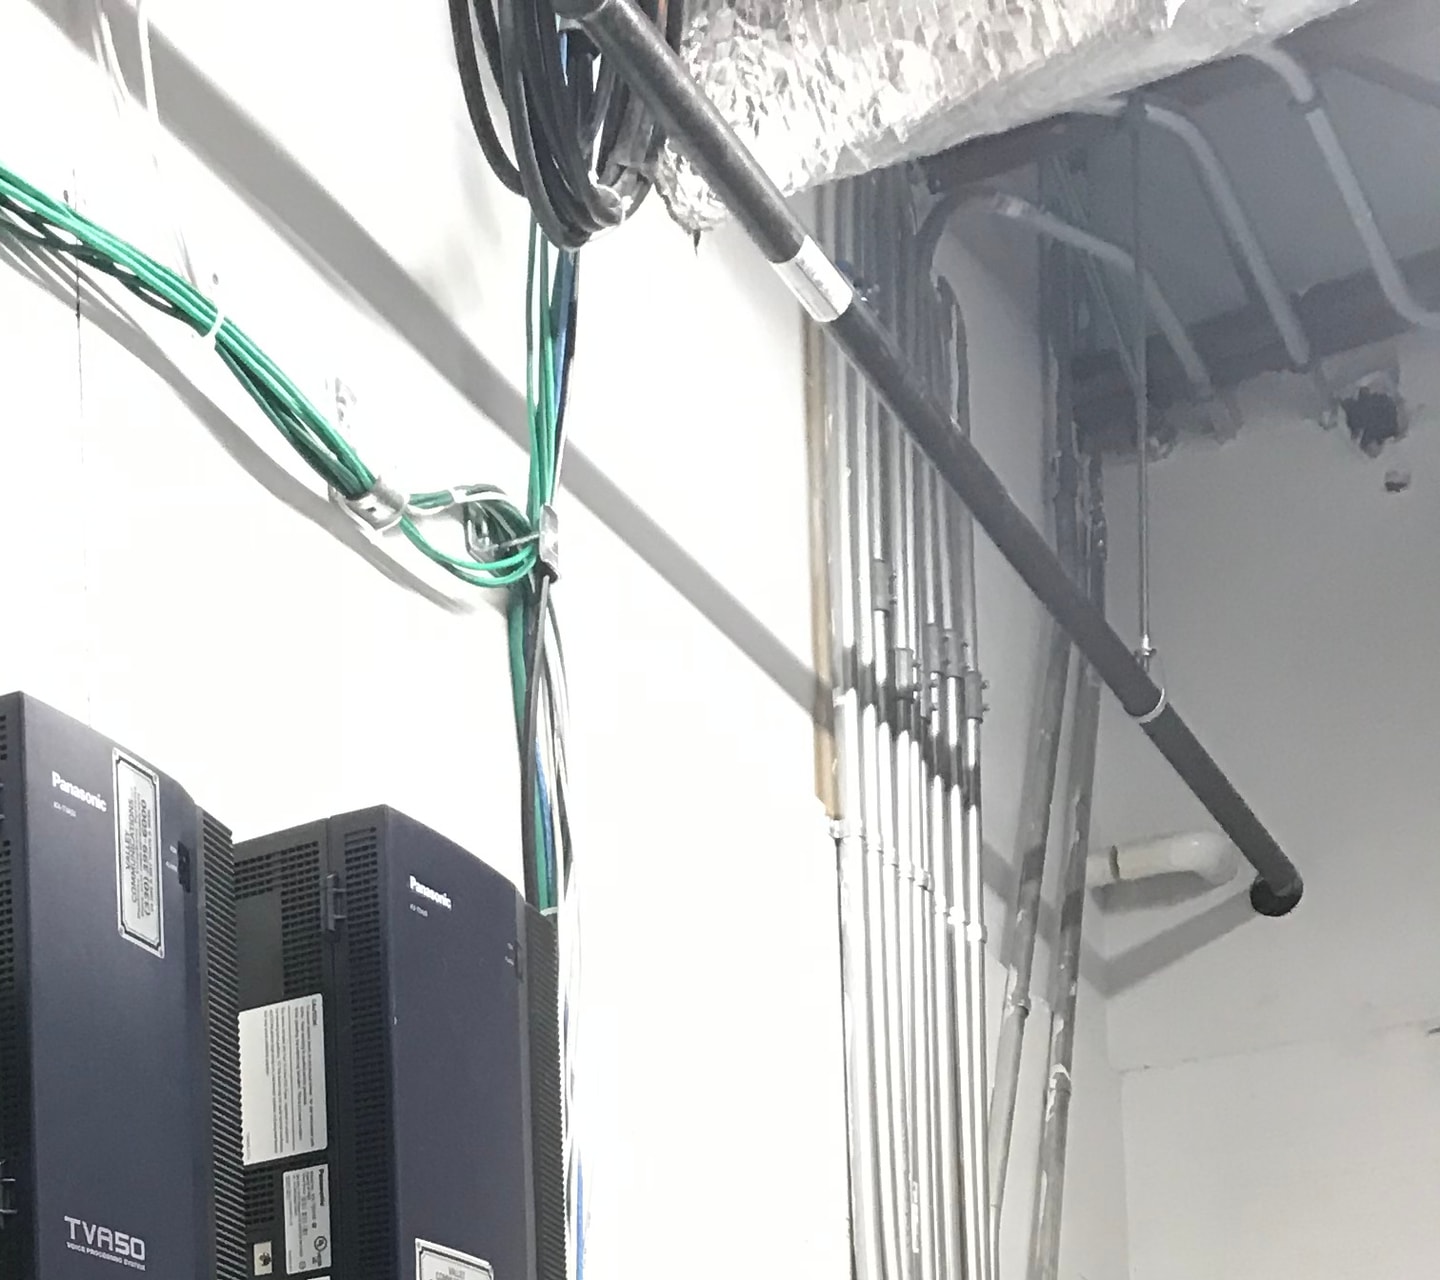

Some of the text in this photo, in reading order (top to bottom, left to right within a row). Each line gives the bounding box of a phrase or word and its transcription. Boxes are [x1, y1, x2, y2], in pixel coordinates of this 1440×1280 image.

[52, 771, 106, 812] Panasonic
[409, 875, 451, 910] Panasonic
[64, 1215, 146, 1260] TVA50
